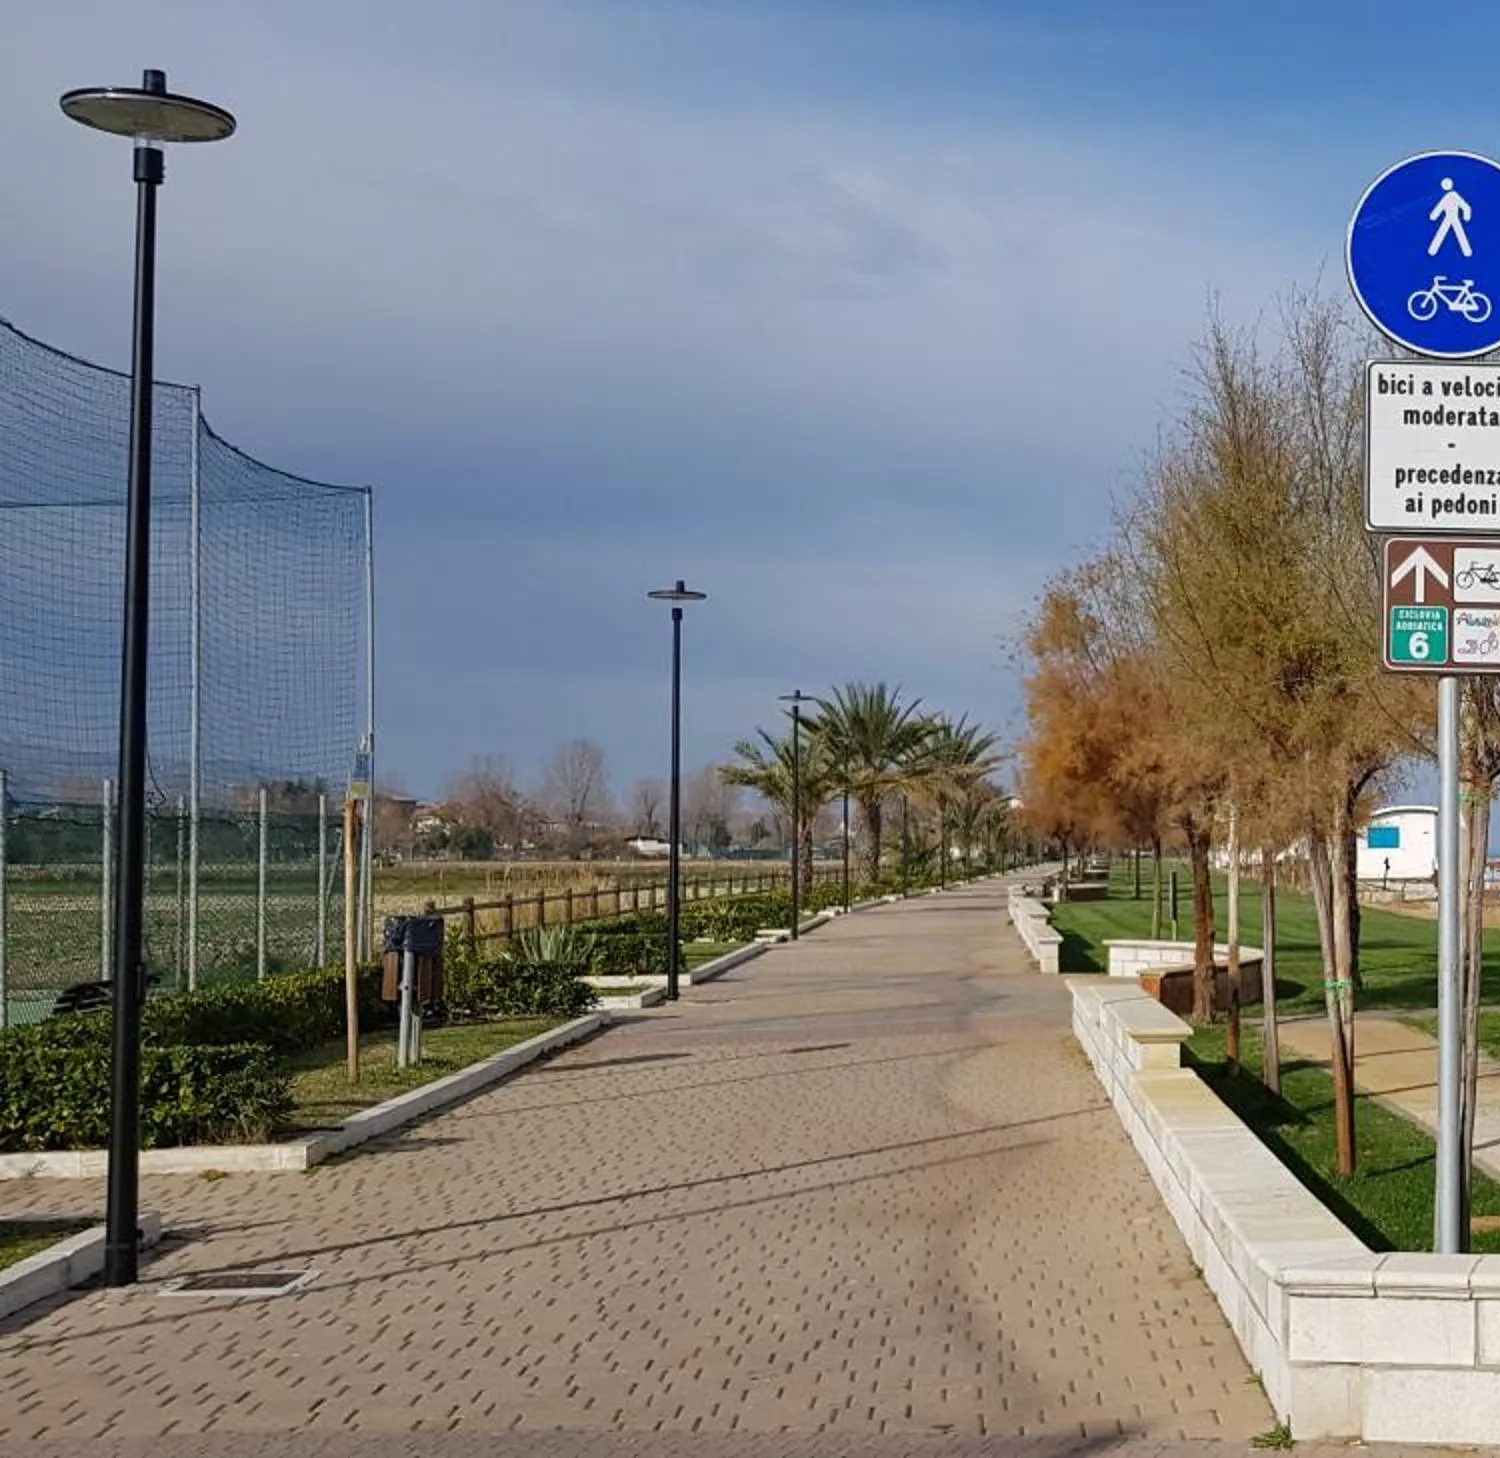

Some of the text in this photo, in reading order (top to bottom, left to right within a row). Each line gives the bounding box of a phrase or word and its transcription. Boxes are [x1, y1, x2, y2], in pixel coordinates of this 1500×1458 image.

[1378, 373, 1414, 395] bici
[1422, 380, 1433, 395] a
[1403, 404, 1500, 427] moderata
[1405, 491, 1497, 519] ai pedoni
[1398, 609, 1441, 620] CICLOVIA
[1396, 621, 1443, 632] ADRIATICA
[1409, 631, 1430, 659] 6
